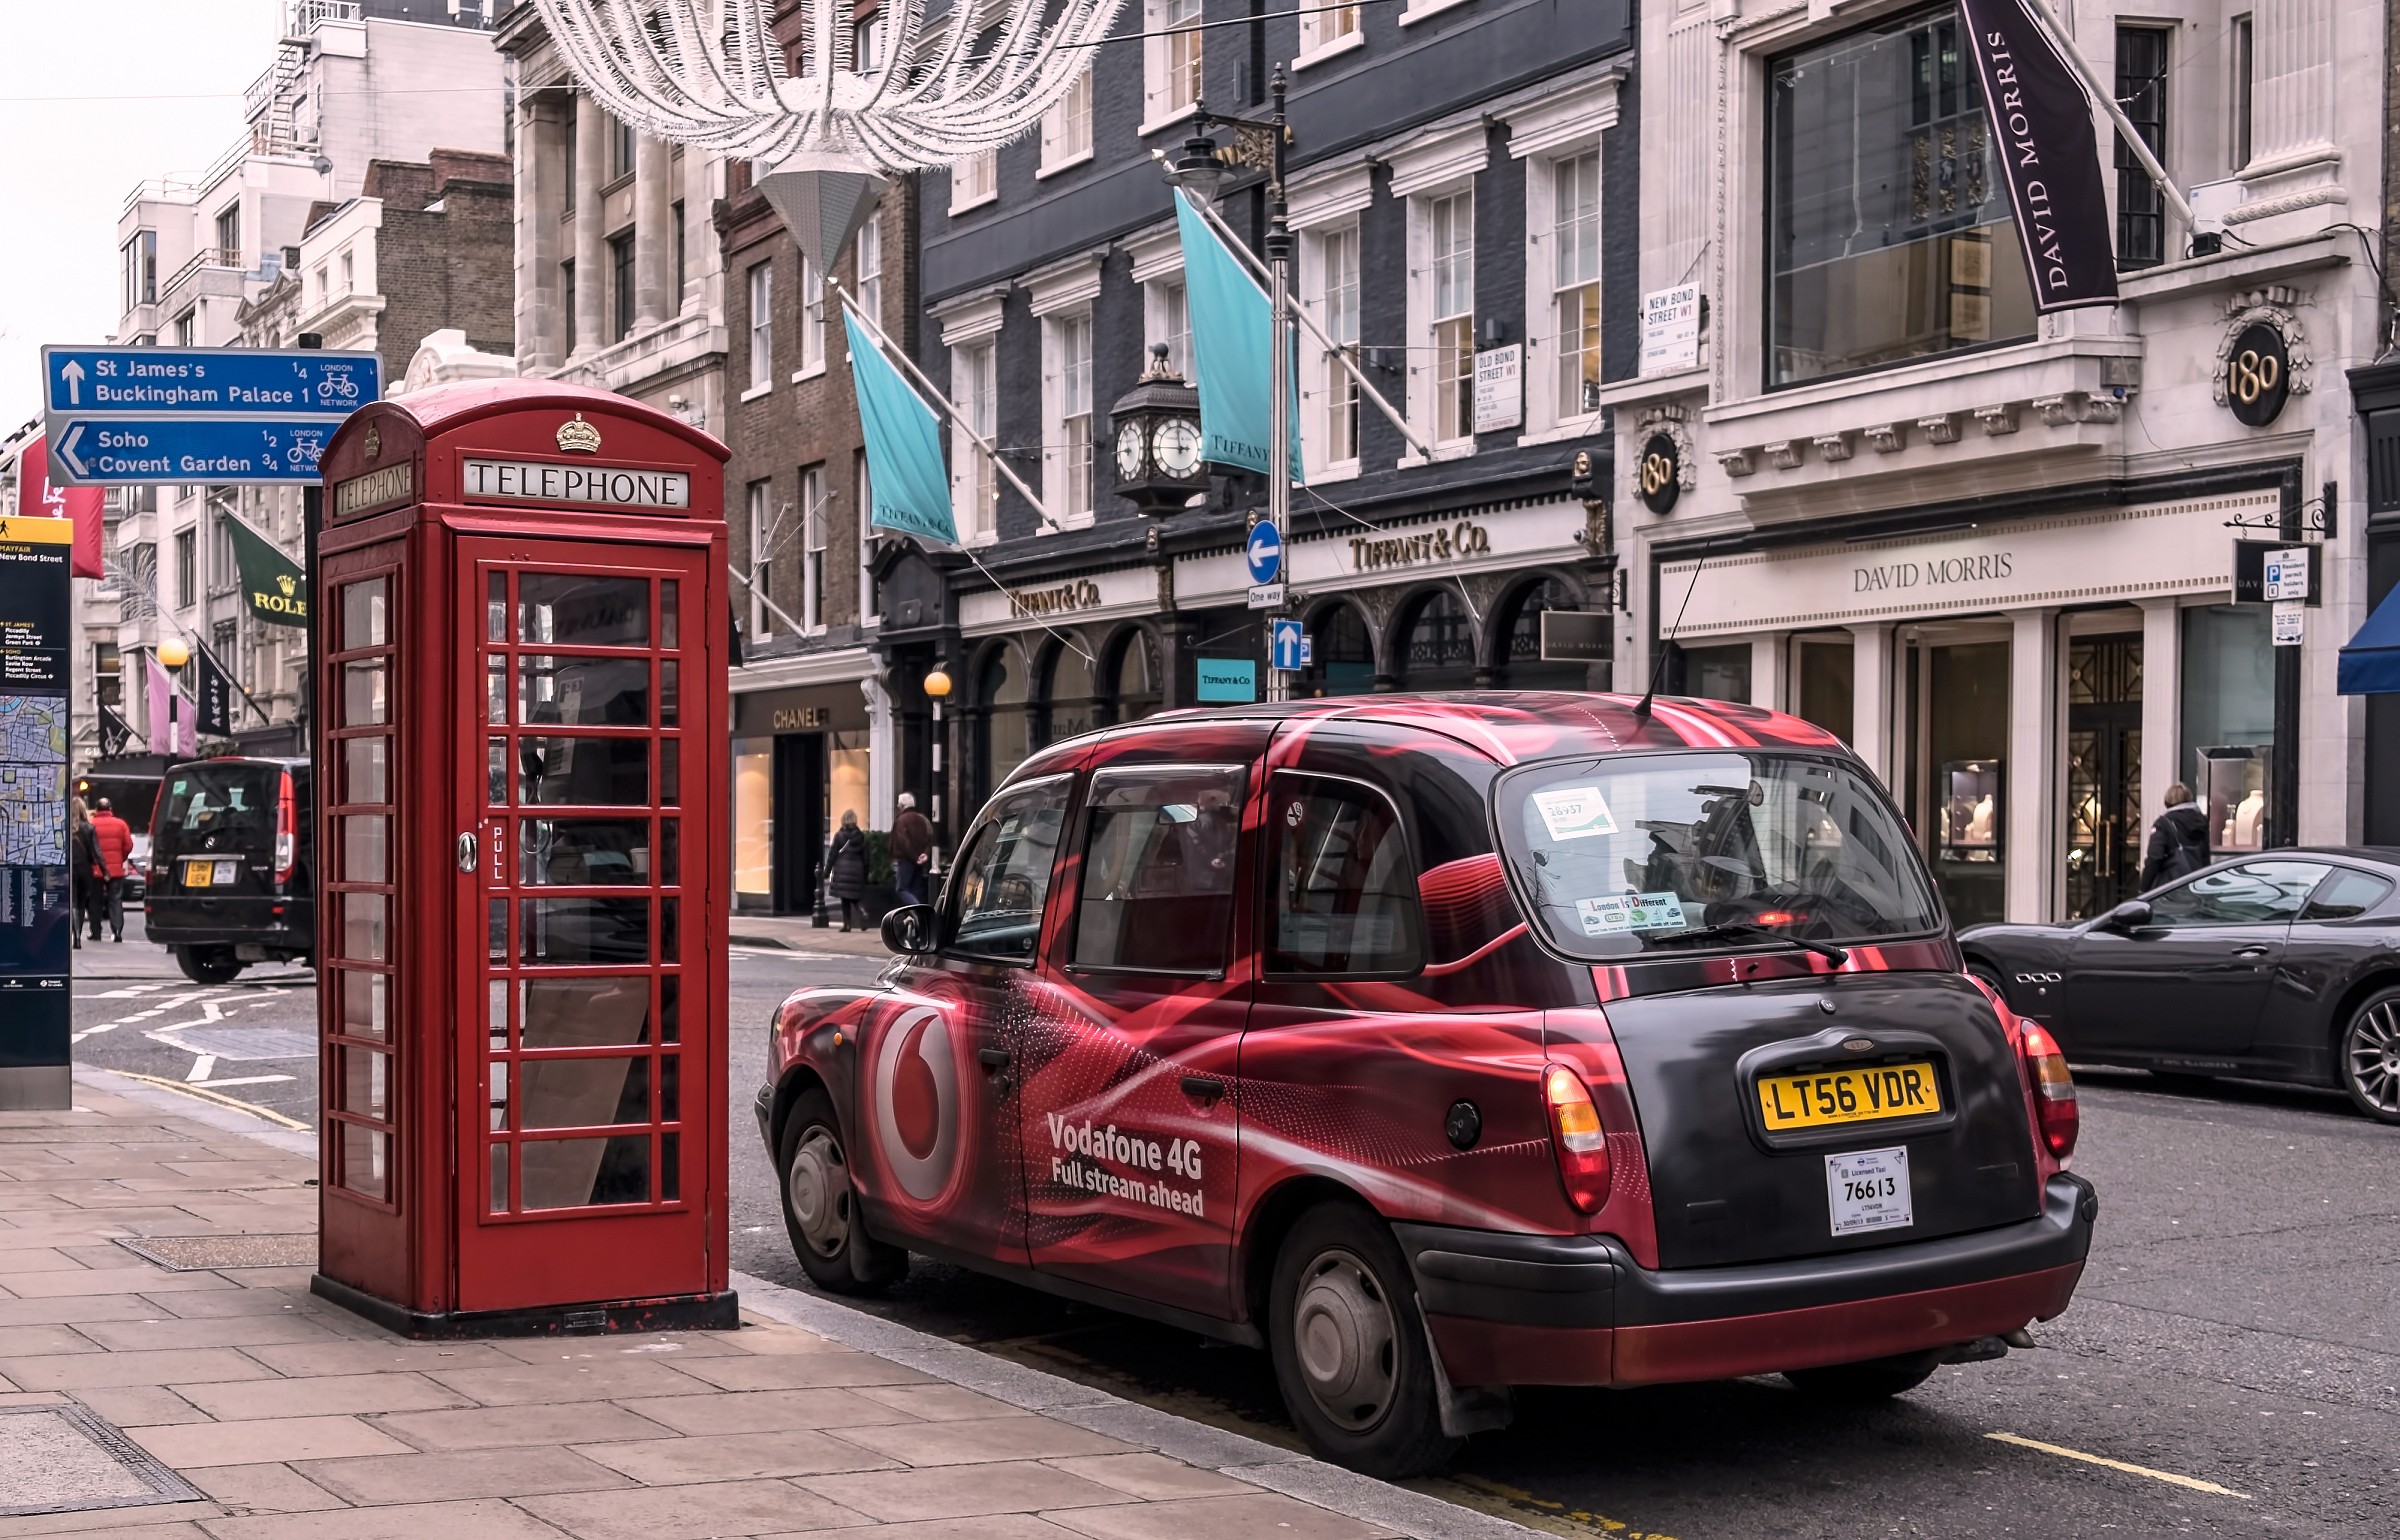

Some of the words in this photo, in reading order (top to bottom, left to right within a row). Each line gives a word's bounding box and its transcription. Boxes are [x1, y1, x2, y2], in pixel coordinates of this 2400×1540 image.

[1986, 31, 2040, 168] MORRIS
[2026, 180, 2069, 292] DAVID
[1649, 296, 1668, 310] NEW
[1671, 289, 1694, 305] BOND
[1648, 307, 1677, 326] STREET
[1680, 304, 1692, 317] W1
[95, 359, 118, 378] St
[126, 360, 205, 378] James's
[319, 363, 353, 372] LONDON
[1479, 355, 1492, 369] OLD
[1495, 350, 1515, 365] BOND
[1479, 367, 1503, 382] STREET
[1505, 364, 1516, 376] W1
[2229, 349, 2279, 405] 180
[96, 385, 218, 403] Buckingham
[228, 386, 293, 403] Palace
[301, 388, 310, 403] 1
[319, 398, 359, 408] NETWORK
[98, 430, 149, 447] Soho
[289, 429, 323, 438] LONDON
[98, 456, 170, 473] Covent
[180, 455, 251, 473] Garden
[289, 464, 318, 473] NETWO
[1641, 453, 1672, 495] 180
[338, 463, 413, 514] TELEPHONE
[469, 463, 679, 506] TELEPHONE
[18, 553, 38, 562] Bond
[39, 554, 63, 563] Street
[1854, 562, 1919, 593] DAVID
[1927, 552, 2013, 586] MORRIS
[253, 592, 307, 617] ROLE
[1250, 591, 1265, 603] One
[1267, 590, 1282, 602] way
[773, 706, 820, 730] CHANEL
[493, 826, 503, 880] PULL
[1590, 900, 1620, 912] London
[1620, 898, 1630, 909] Is
[1631, 896, 1668, 908] Different
[1770, 1075, 1858, 1121] LT56
[1862, 1069, 1925, 1110] VDR
[1047, 1111, 1162, 1171] Vodafone
[1166, 1137, 1203, 1181] 4G
[1851, 1168, 1875, 1177] Licensed
[1876, 1165, 1887, 1174] Taxi
[1051, 1156, 1085, 1189] Full
[1086, 1167, 1146, 1204] stream
[1149, 1180, 1205, 1218] ahead
[1844, 1177, 1896, 1202] 76613
